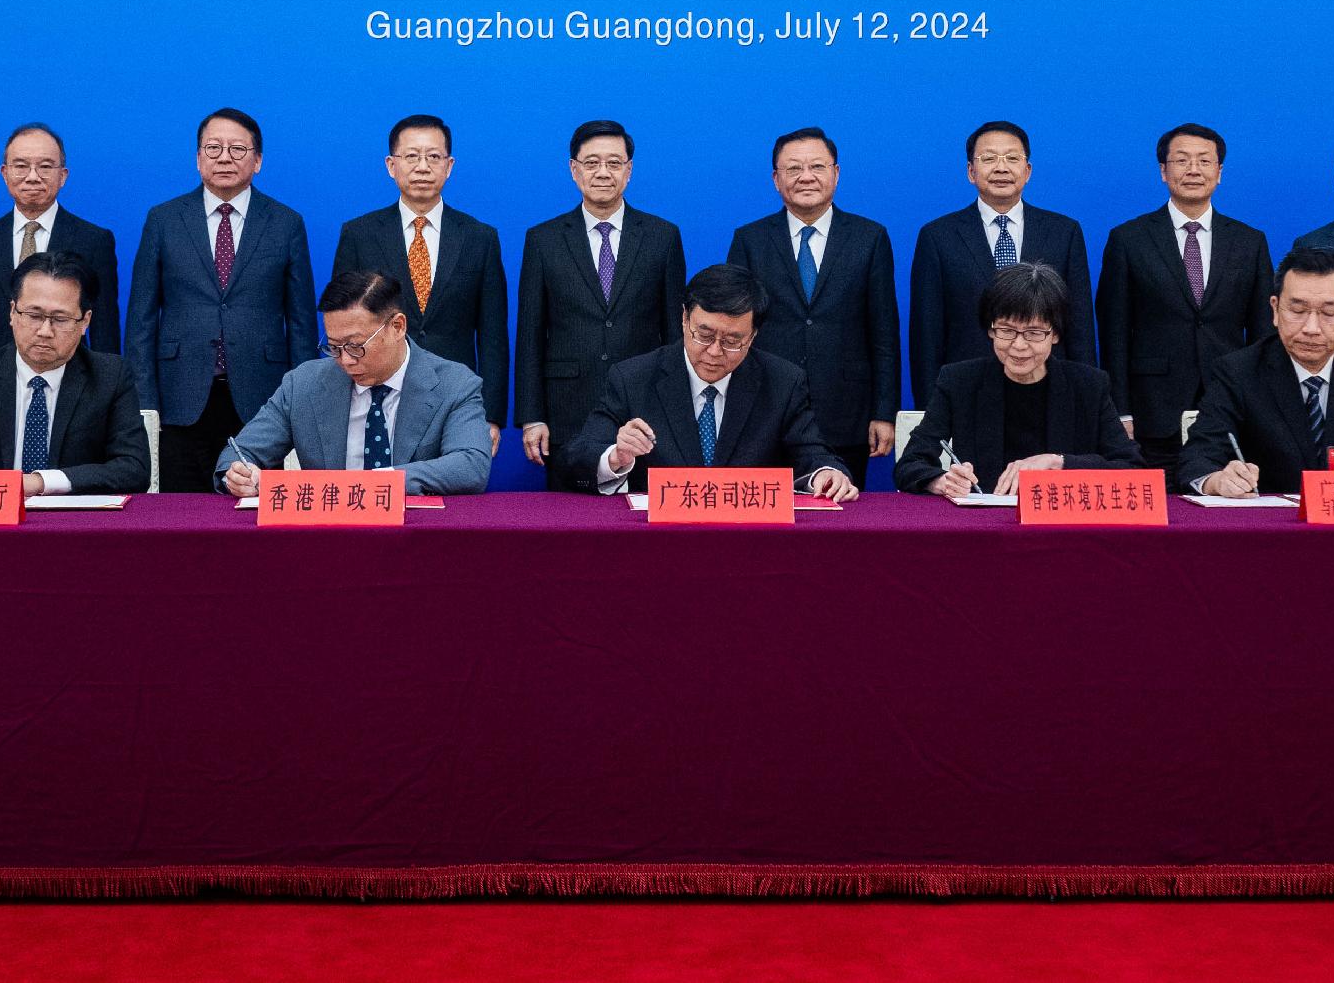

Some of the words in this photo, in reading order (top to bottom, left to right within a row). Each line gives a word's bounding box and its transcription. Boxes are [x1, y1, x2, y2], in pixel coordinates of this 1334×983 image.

[366, 10, 554, 46] Guangzhou
[565, 10, 764, 46] Guangdong,
[775, 10, 841, 46] July
[852, 12, 899, 44] 12,
[910, 12, 989, 39] 2024
[269, 482, 393, 512] 香港律政司
[659, 480, 781, 509] 广东省司法厅
[1030, 482, 1155, 512] 香港环境及生态局
